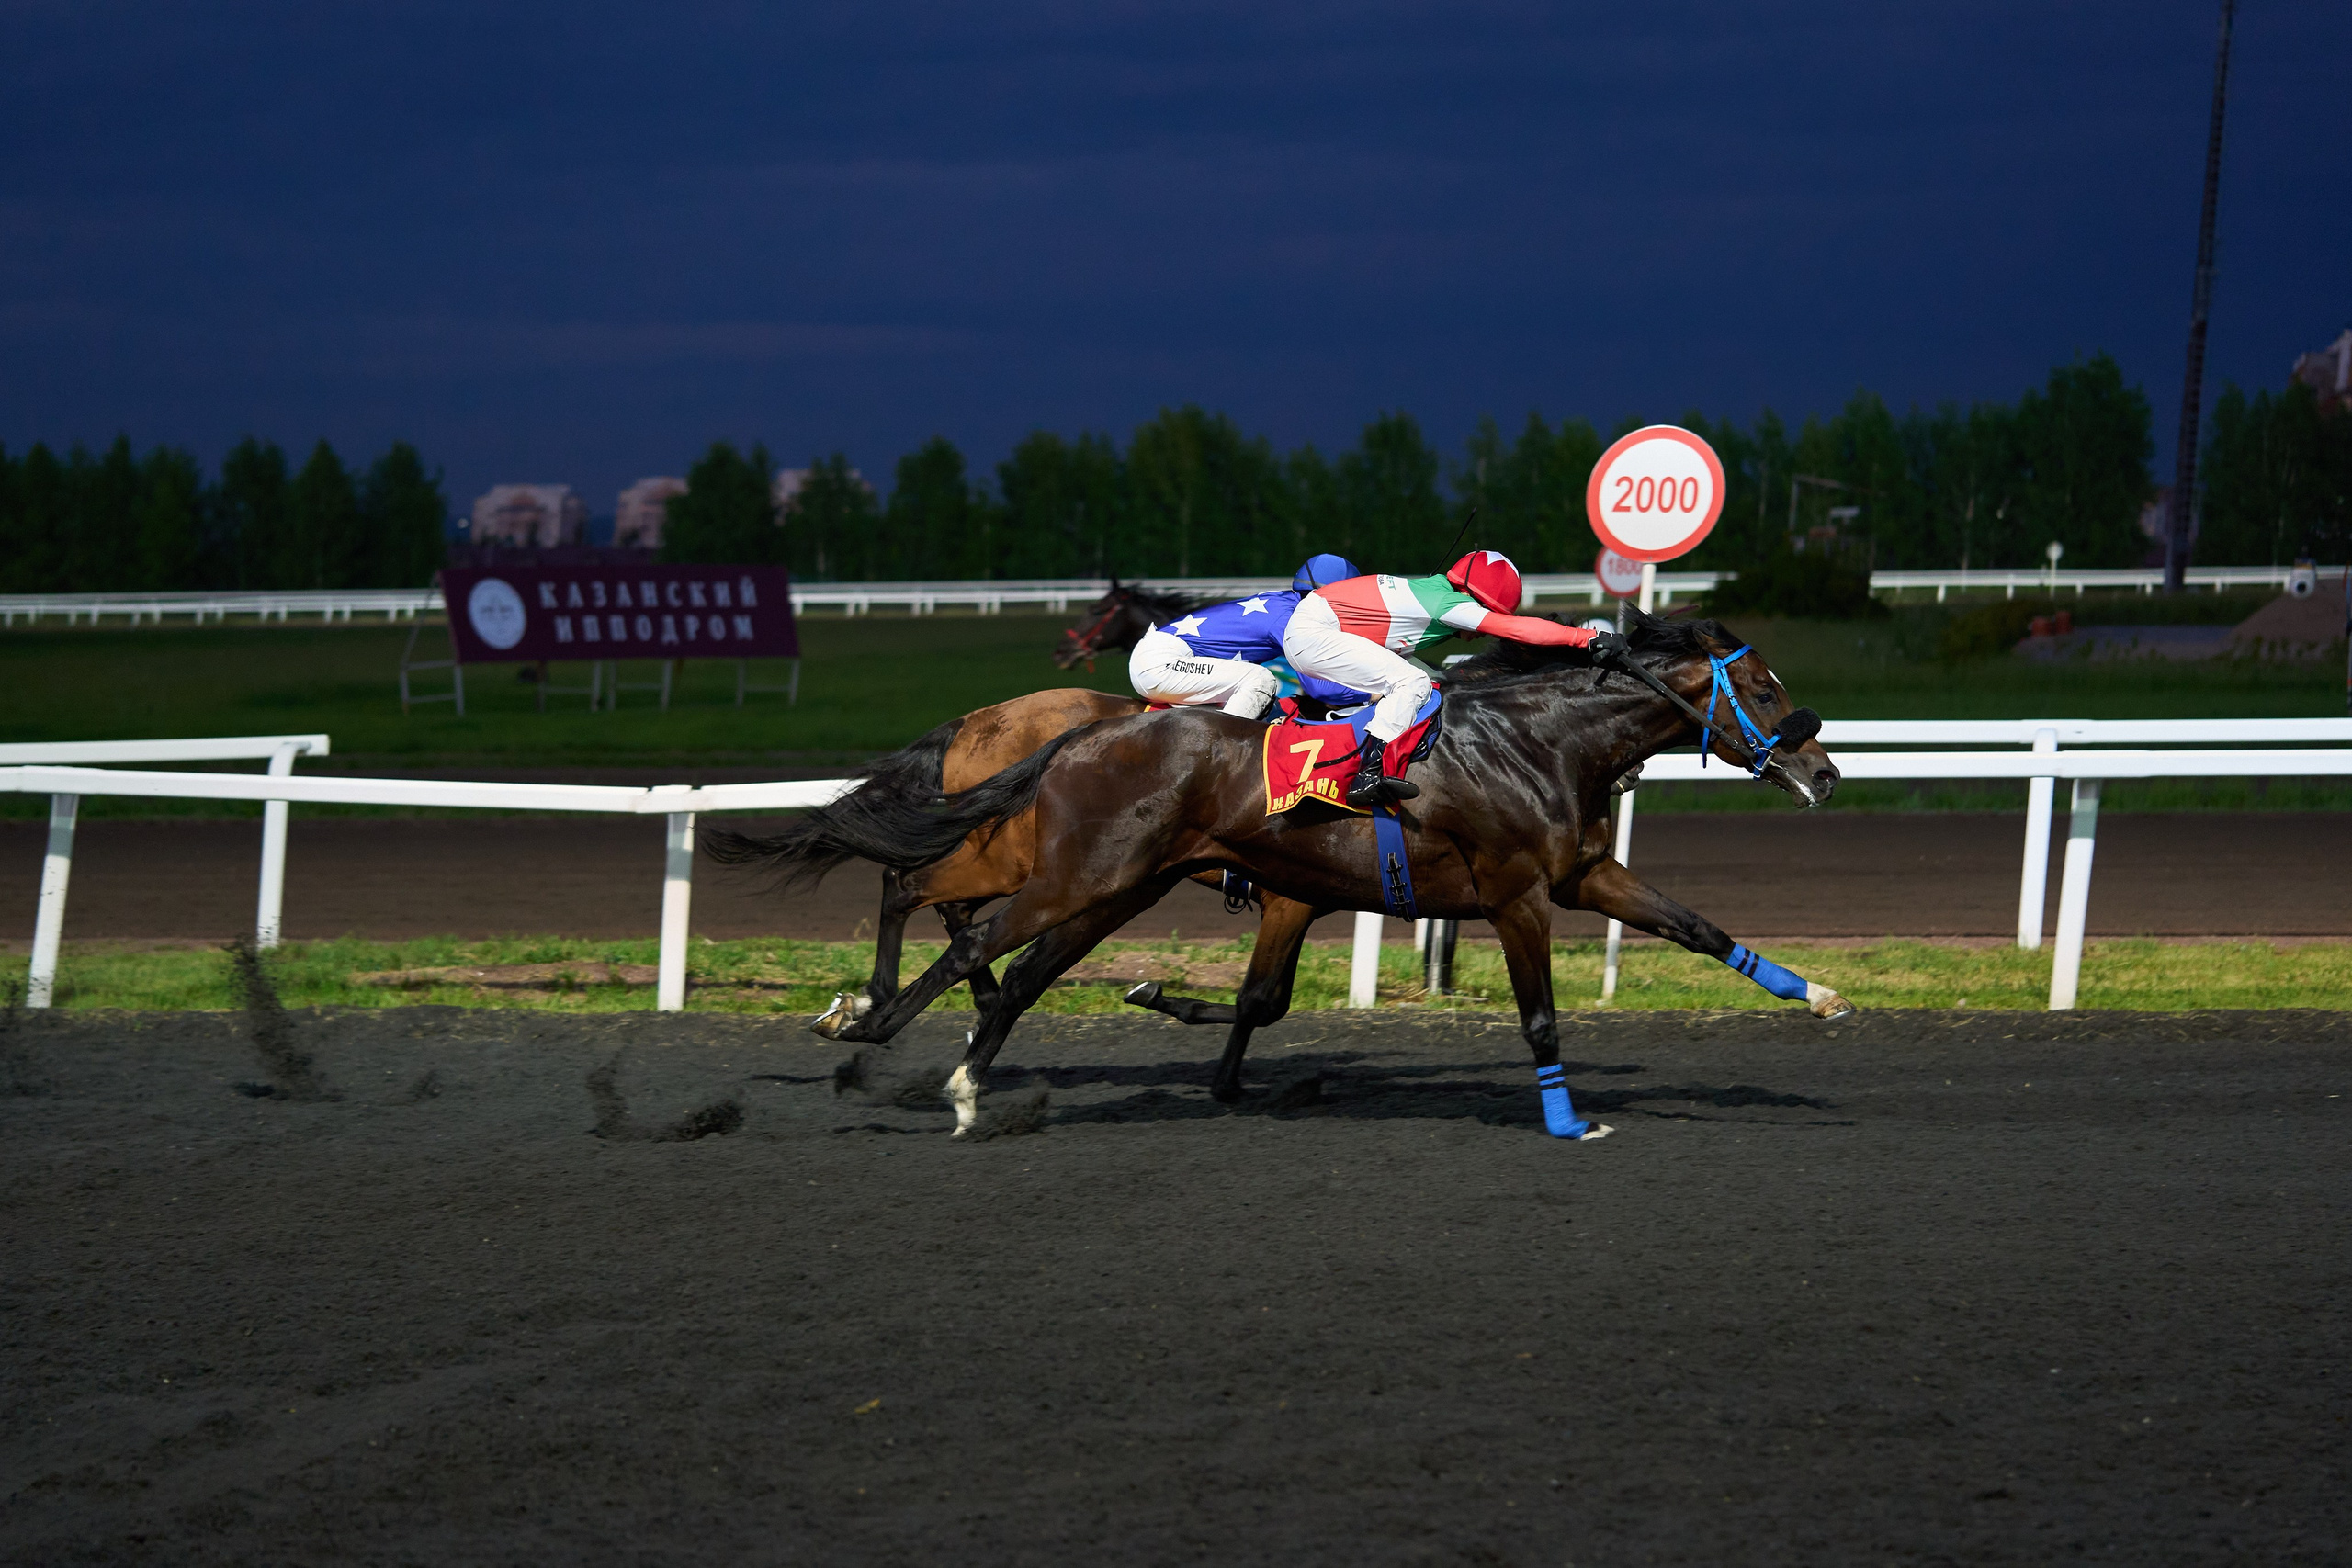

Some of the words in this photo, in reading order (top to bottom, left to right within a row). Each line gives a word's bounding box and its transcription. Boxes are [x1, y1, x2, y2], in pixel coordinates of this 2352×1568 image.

[1612, 476, 1699, 513] 2000
[538, 575, 758, 609] КАЗАНСКИЙ
[554, 614, 754, 645] ИППОДРОМ
[1290, 739, 1324, 784] 7
[1272, 777, 1339, 811] КАЗАНЬ
